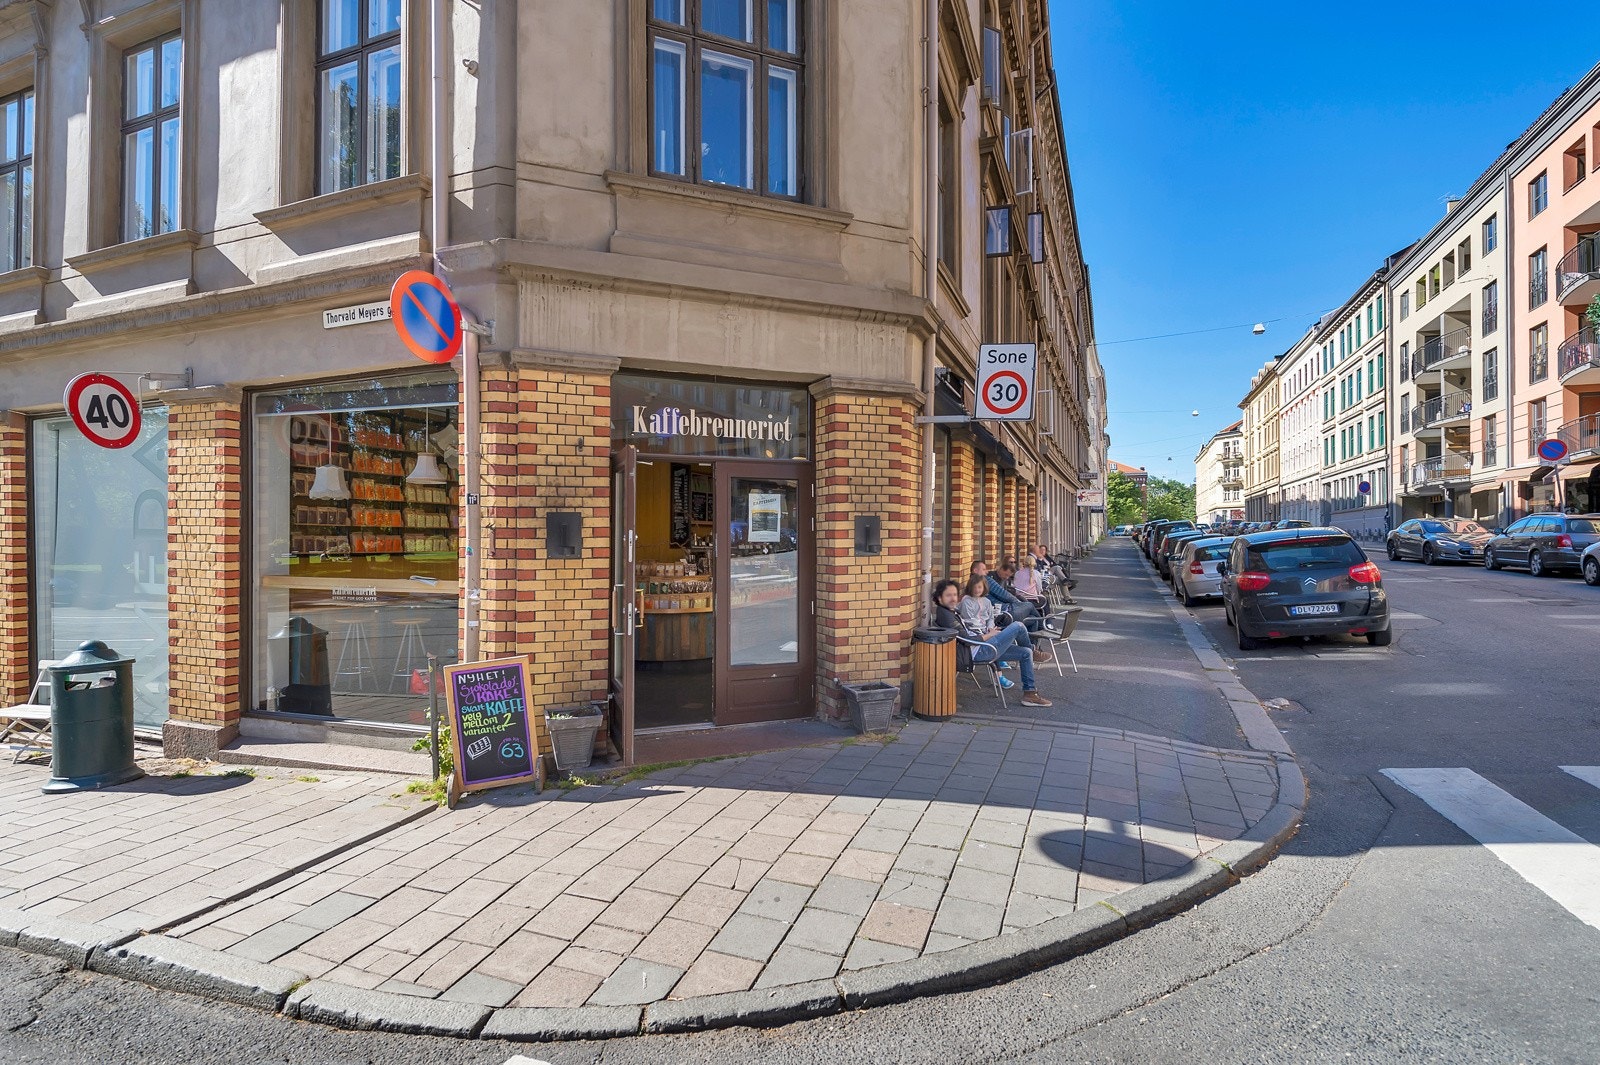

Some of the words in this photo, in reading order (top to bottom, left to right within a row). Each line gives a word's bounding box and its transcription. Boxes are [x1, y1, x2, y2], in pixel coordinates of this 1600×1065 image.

[326, 309, 356, 324] Thorvald
[358, 307, 384, 320] Meyers
[987, 349, 1028, 364] Sone
[991, 383, 1019, 402] 30
[86, 393, 130, 429] 40
[632, 405, 793, 442] Kaffebrenneriet
[1311, 604, 1337, 613] 72269
[476, 689, 513, 702] KAKE
[485, 697, 525, 716] KAFFE
[502, 712, 517, 728] 2
[463, 725, 505, 736] varianter
[501, 743, 524, 758] 63
